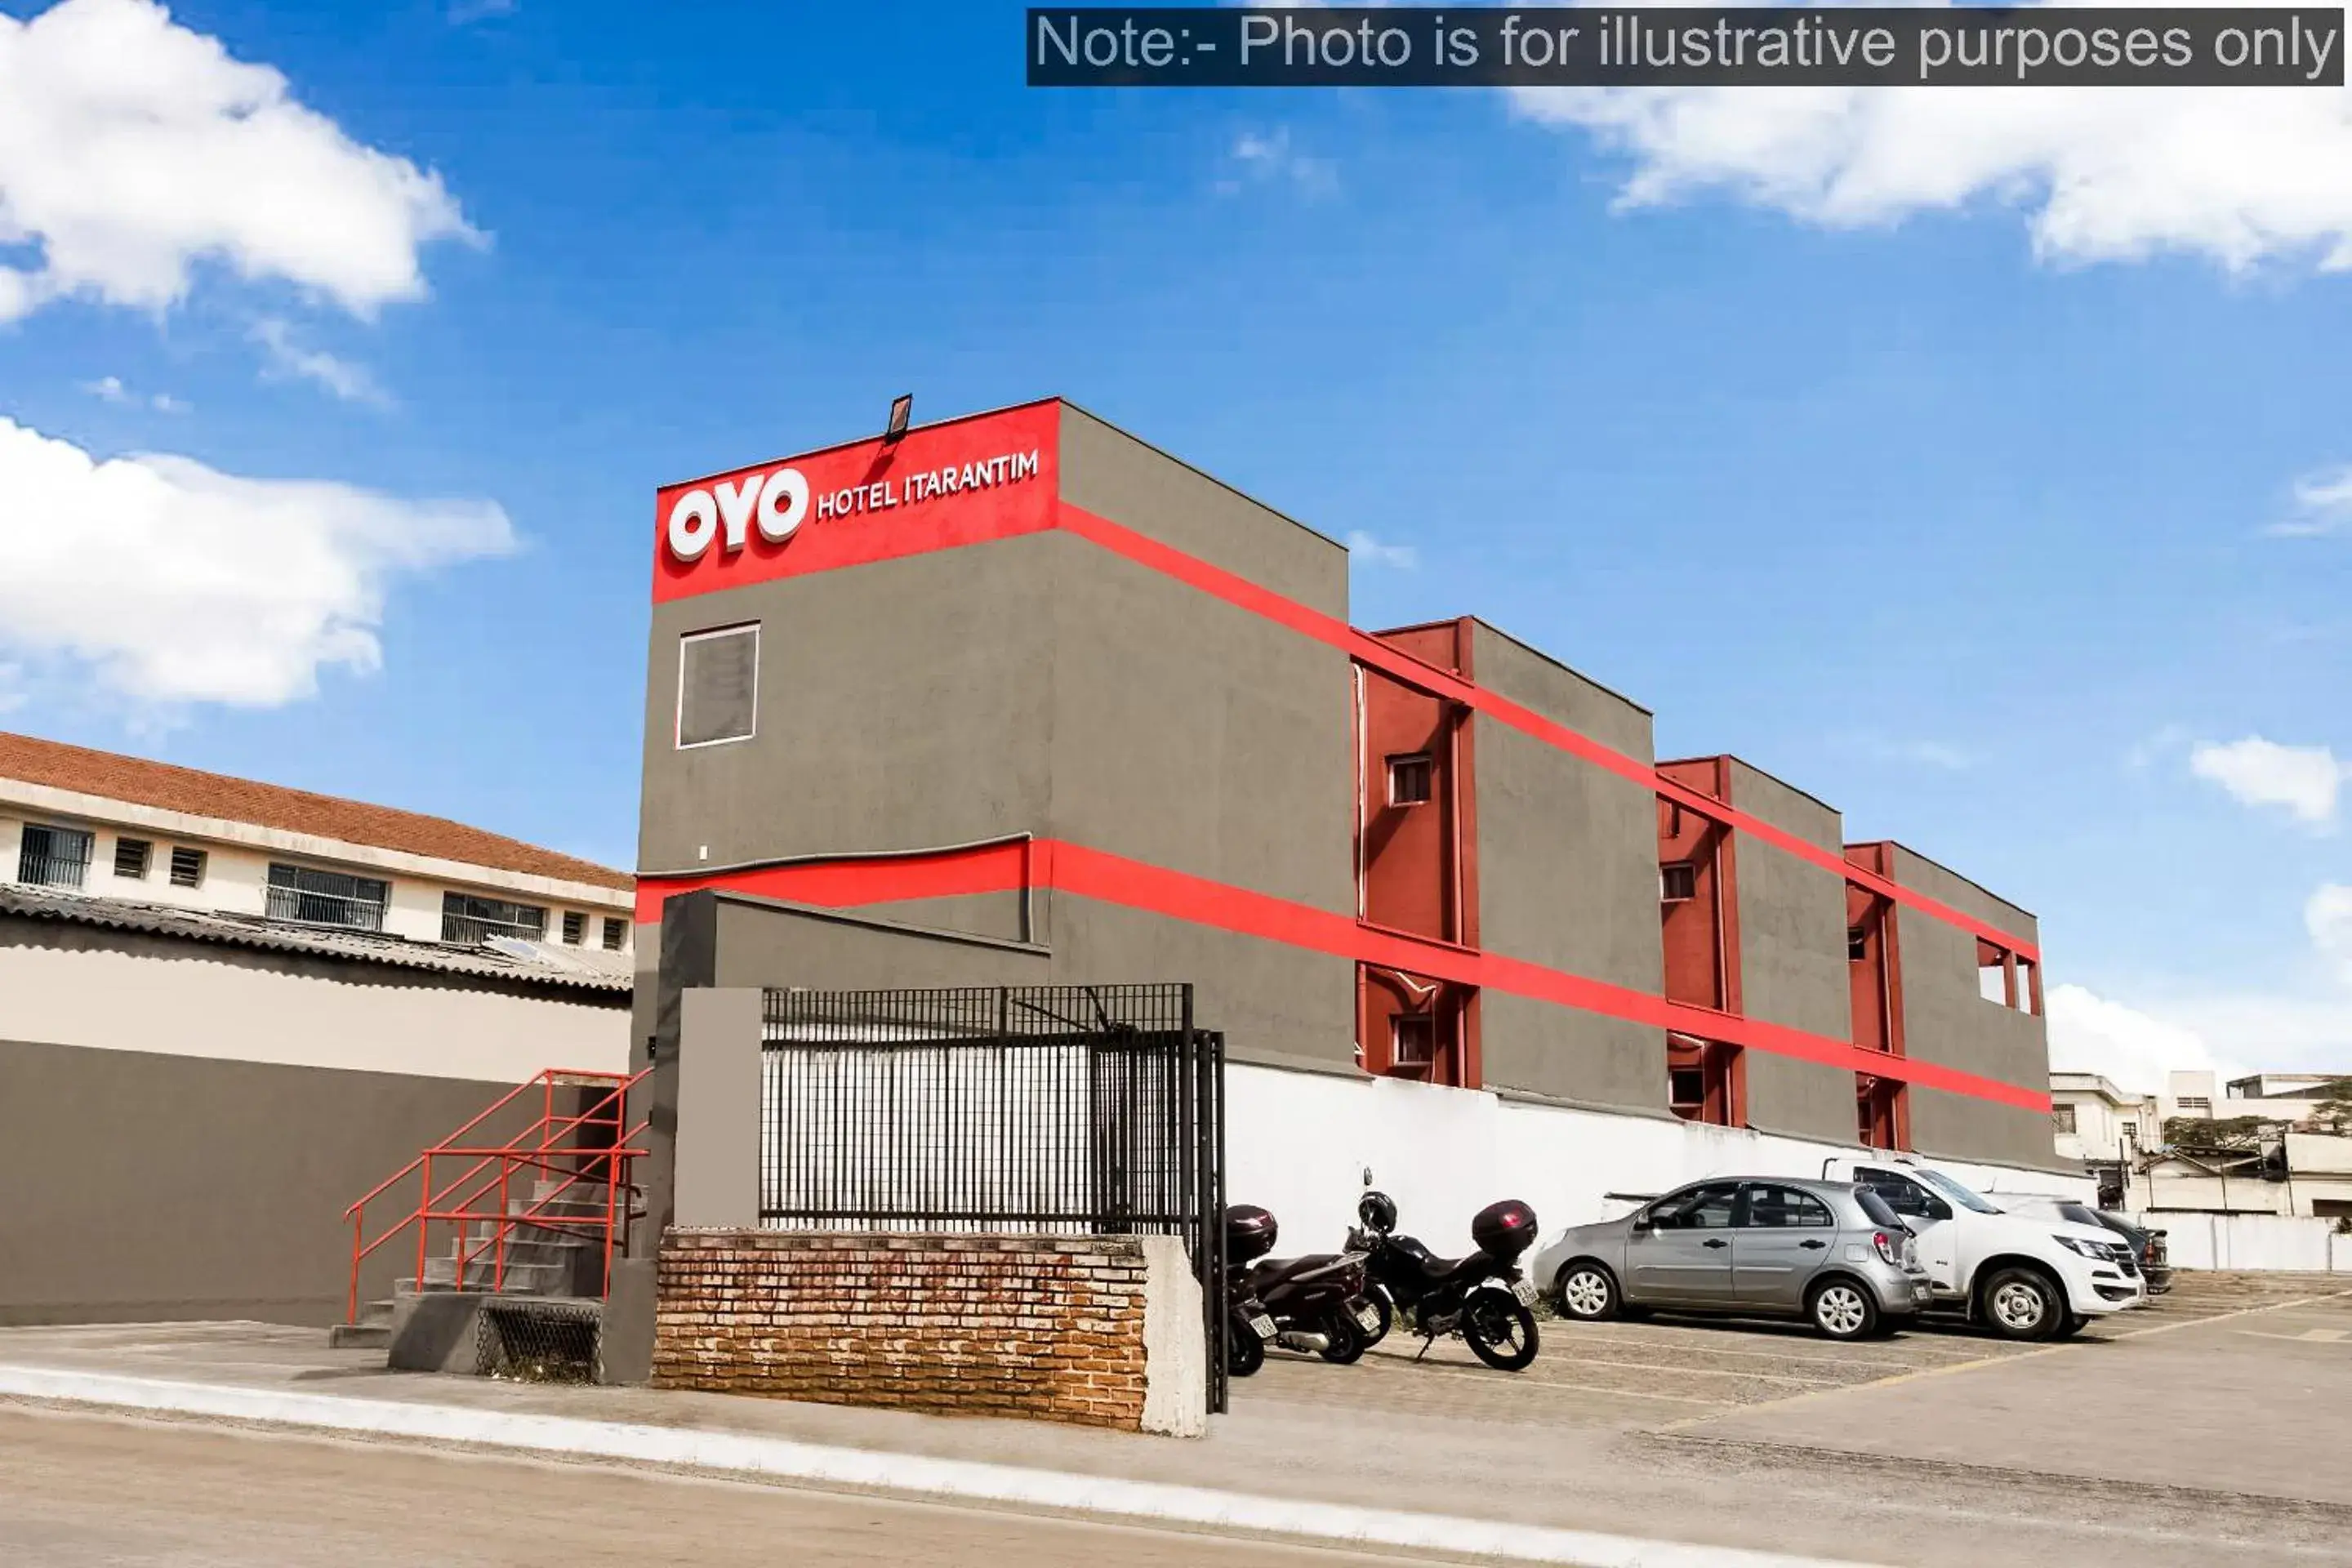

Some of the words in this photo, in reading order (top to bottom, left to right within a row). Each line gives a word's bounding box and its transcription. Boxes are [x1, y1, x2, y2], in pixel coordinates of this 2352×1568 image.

[668, 468, 809, 562] OYO
[817, 481, 898, 521] HOTEL
[903, 448, 1040, 499] ITARANTIM
